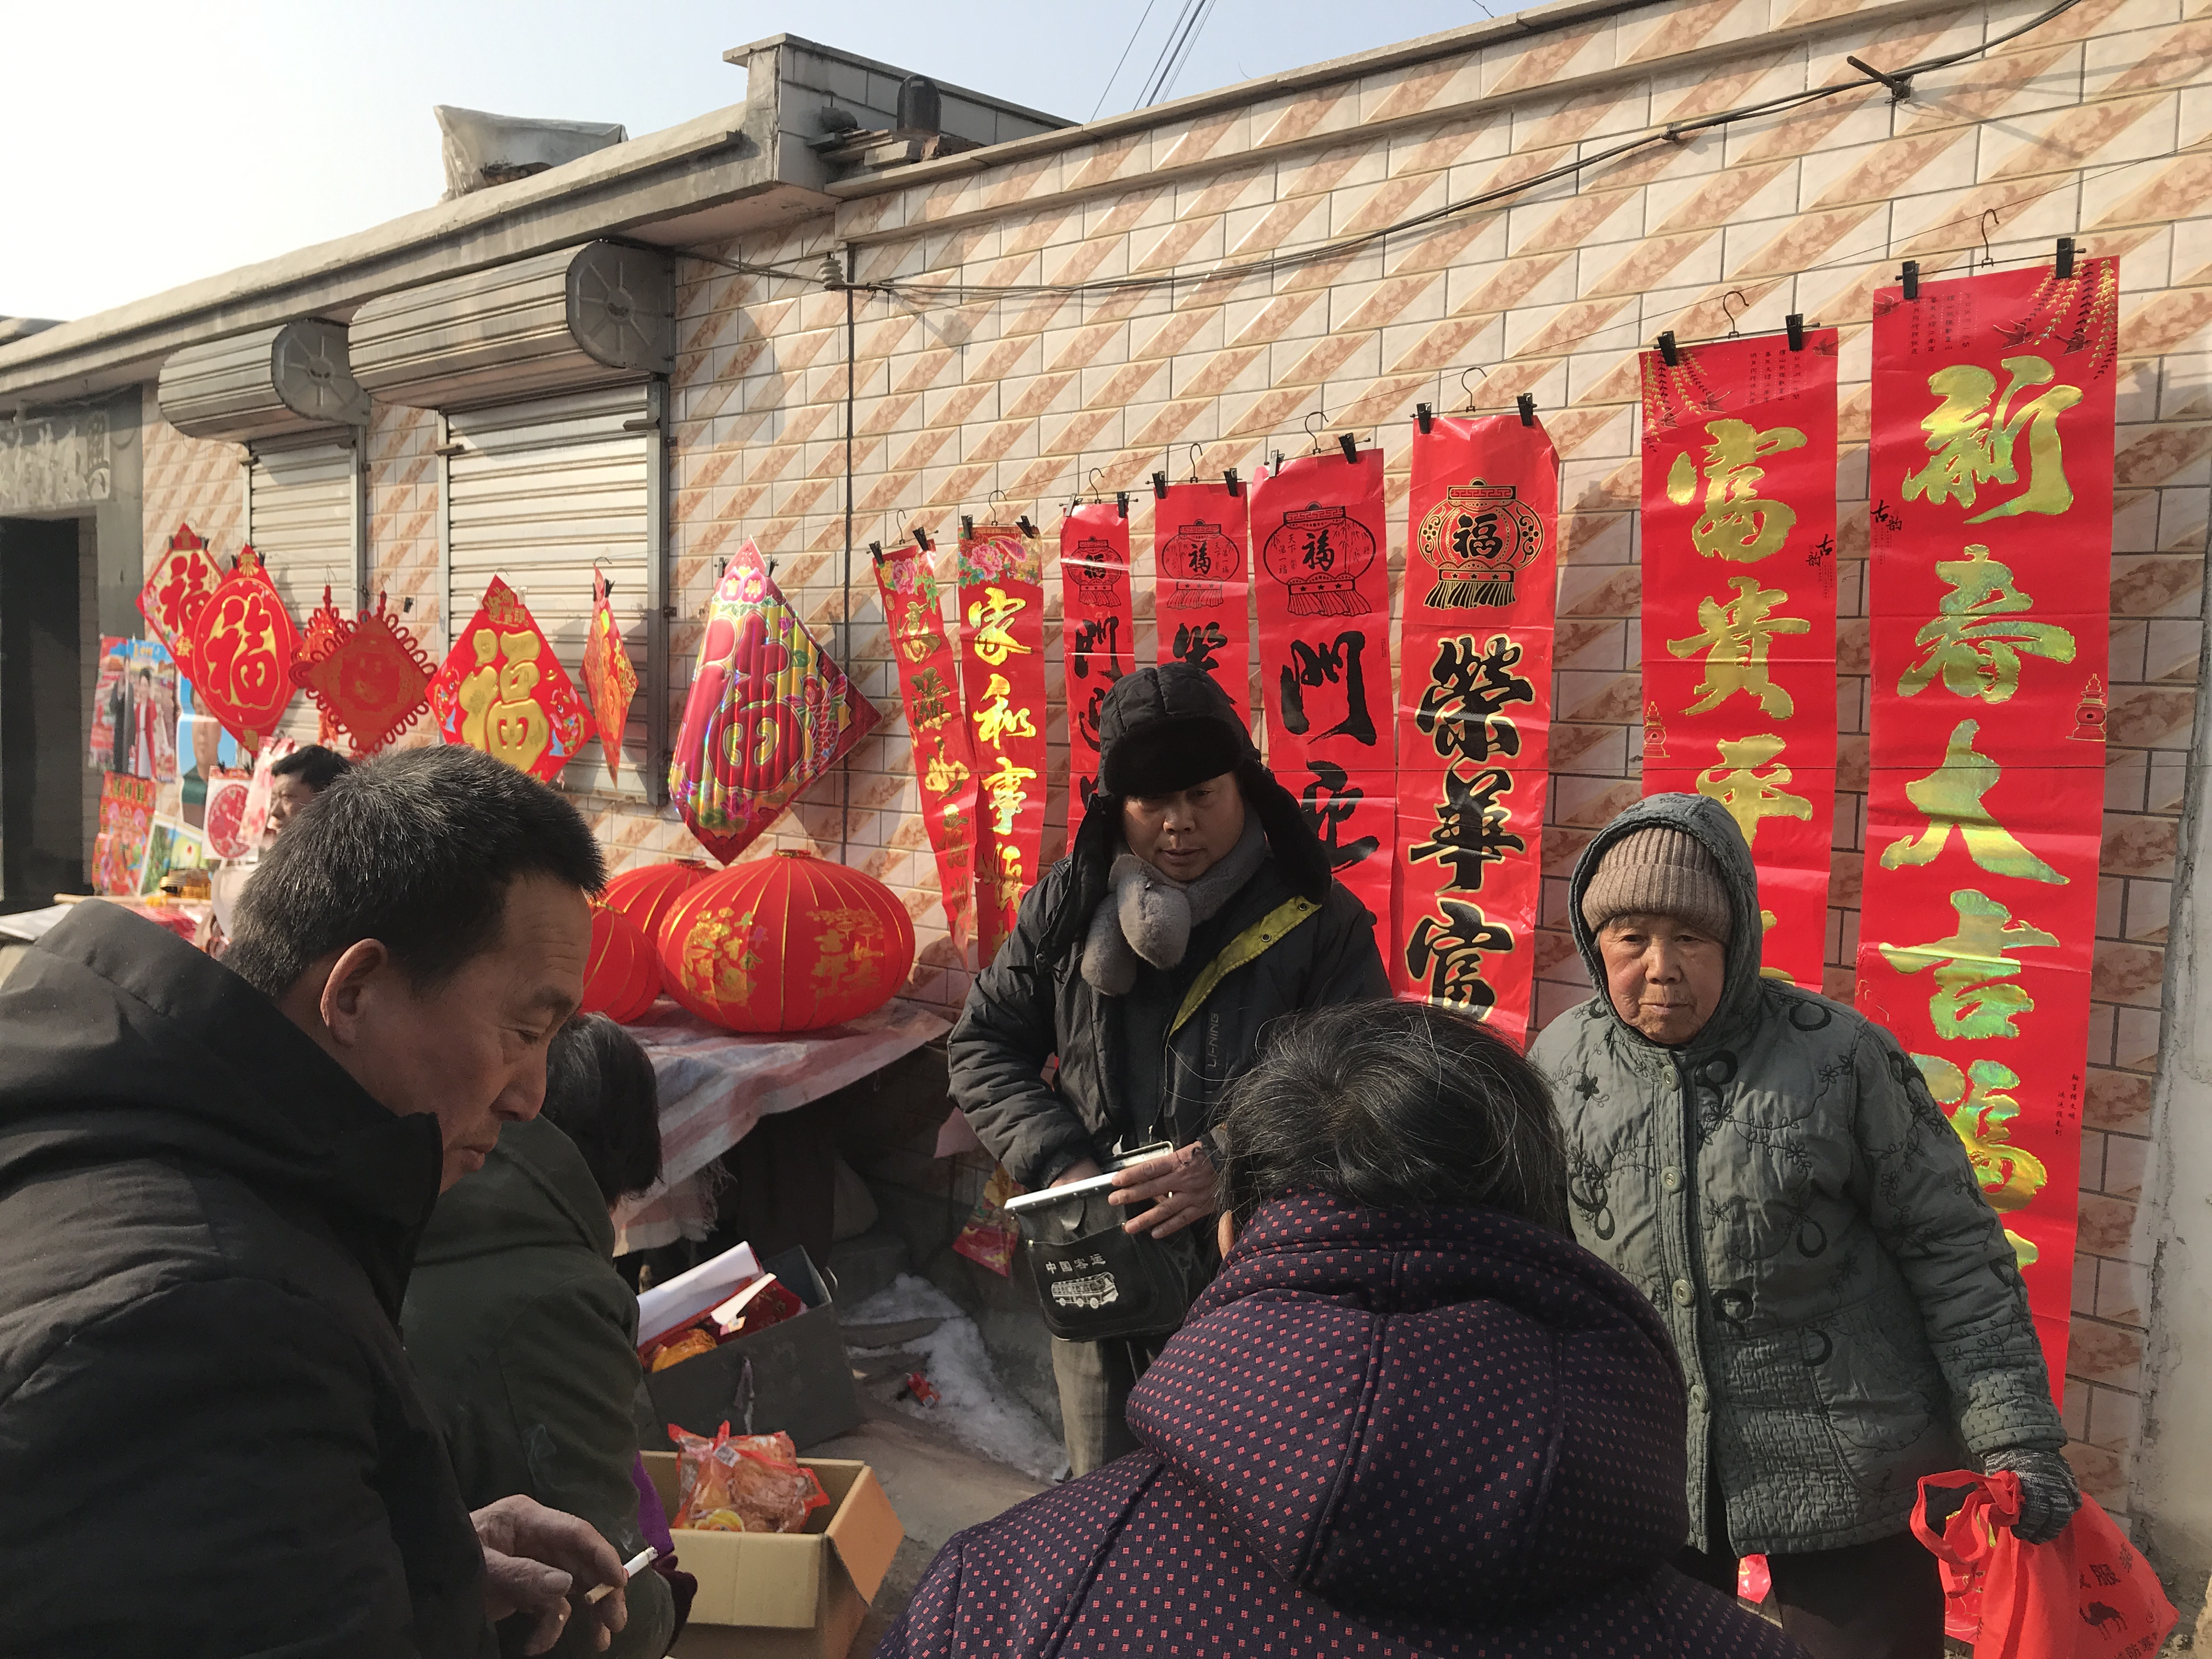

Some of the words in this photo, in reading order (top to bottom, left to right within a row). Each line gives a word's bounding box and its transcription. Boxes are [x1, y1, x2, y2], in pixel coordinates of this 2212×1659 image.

[1453, 512, 1504, 560] 福
[1870, 499, 1903, 532] 古韵
[1188, 540, 1211, 575] 福
[1288, 533, 1296, 554] 天下
[1301, 529, 1334, 572] 福
[1805, 533, 1834, 566] 古韵
[1083, 553, 1107, 579] 福
[159, 552, 213, 633] 福
[205, 592, 280, 710] 福
[459, 628, 549, 774] 福
[674, 611, 805, 793] 福
[1878, 355, 2084, 1268] 新春大吉福
[1045, 1253, 1106, 1274] 中国客运
